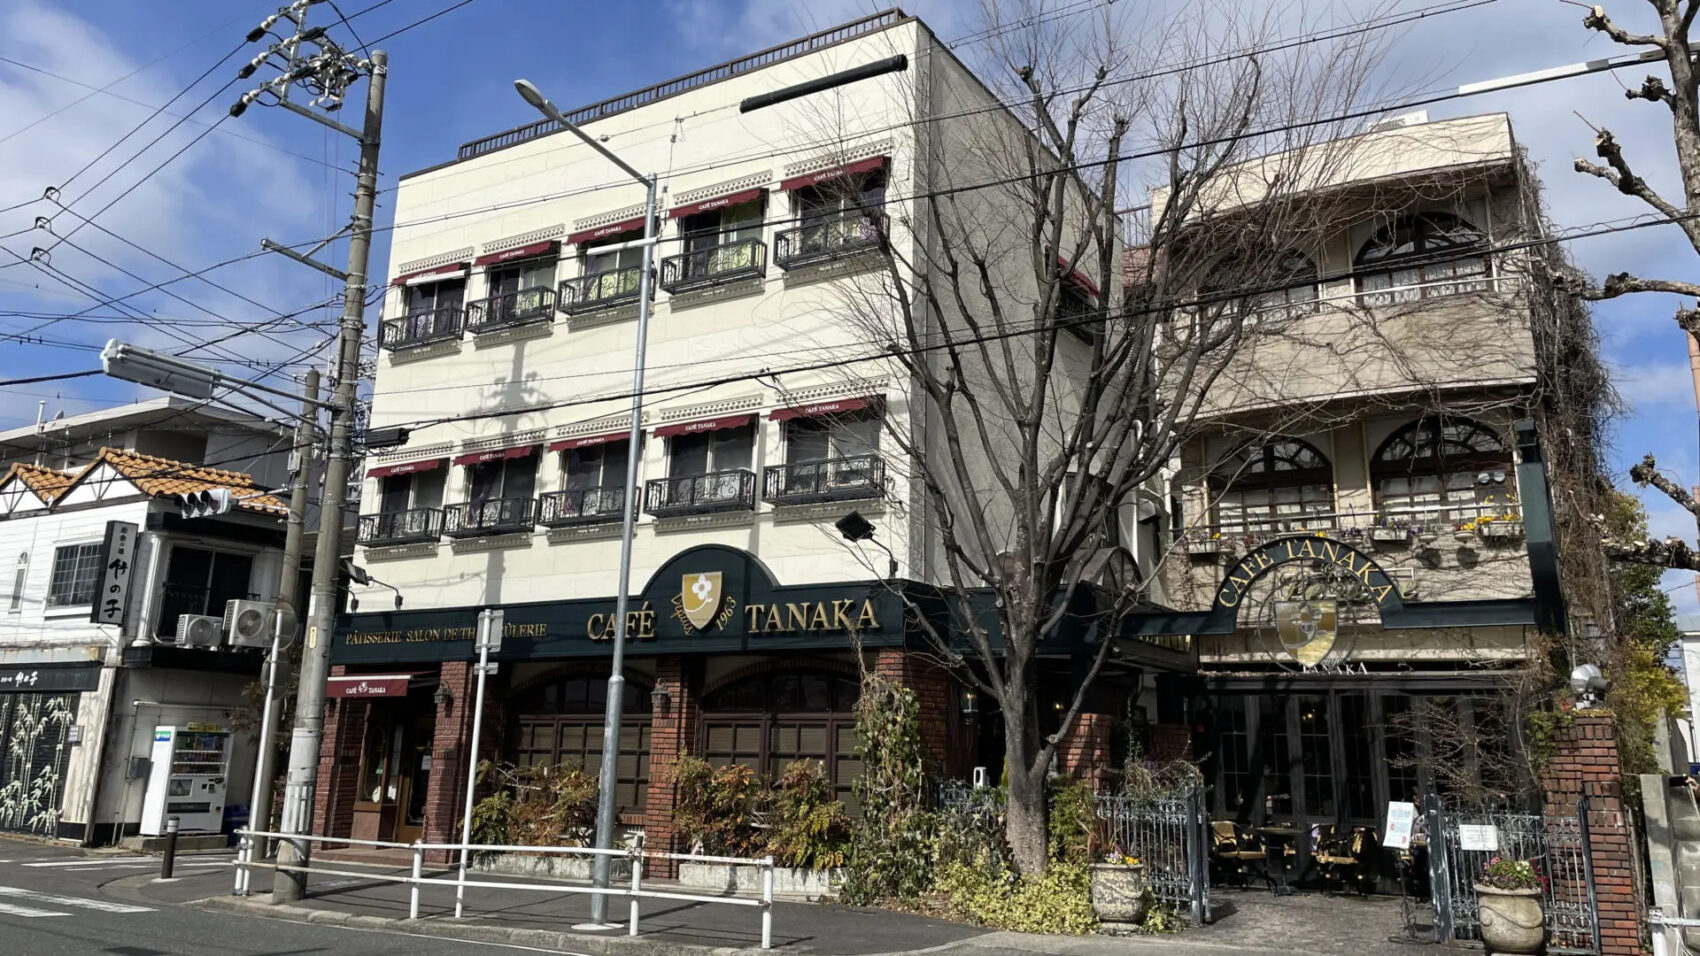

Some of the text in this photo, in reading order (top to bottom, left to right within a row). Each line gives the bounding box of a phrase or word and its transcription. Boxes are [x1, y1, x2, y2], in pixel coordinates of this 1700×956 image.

[103, 558, 128, 619] 竹の子
[1280, 539, 1393, 603] TANAKA
[406, 628, 440, 642] SALON
[443, 627, 458, 641] DE
[586, 598, 880, 640] CAFÉ TANAKA
[716, 596, 737, 632] 1963
